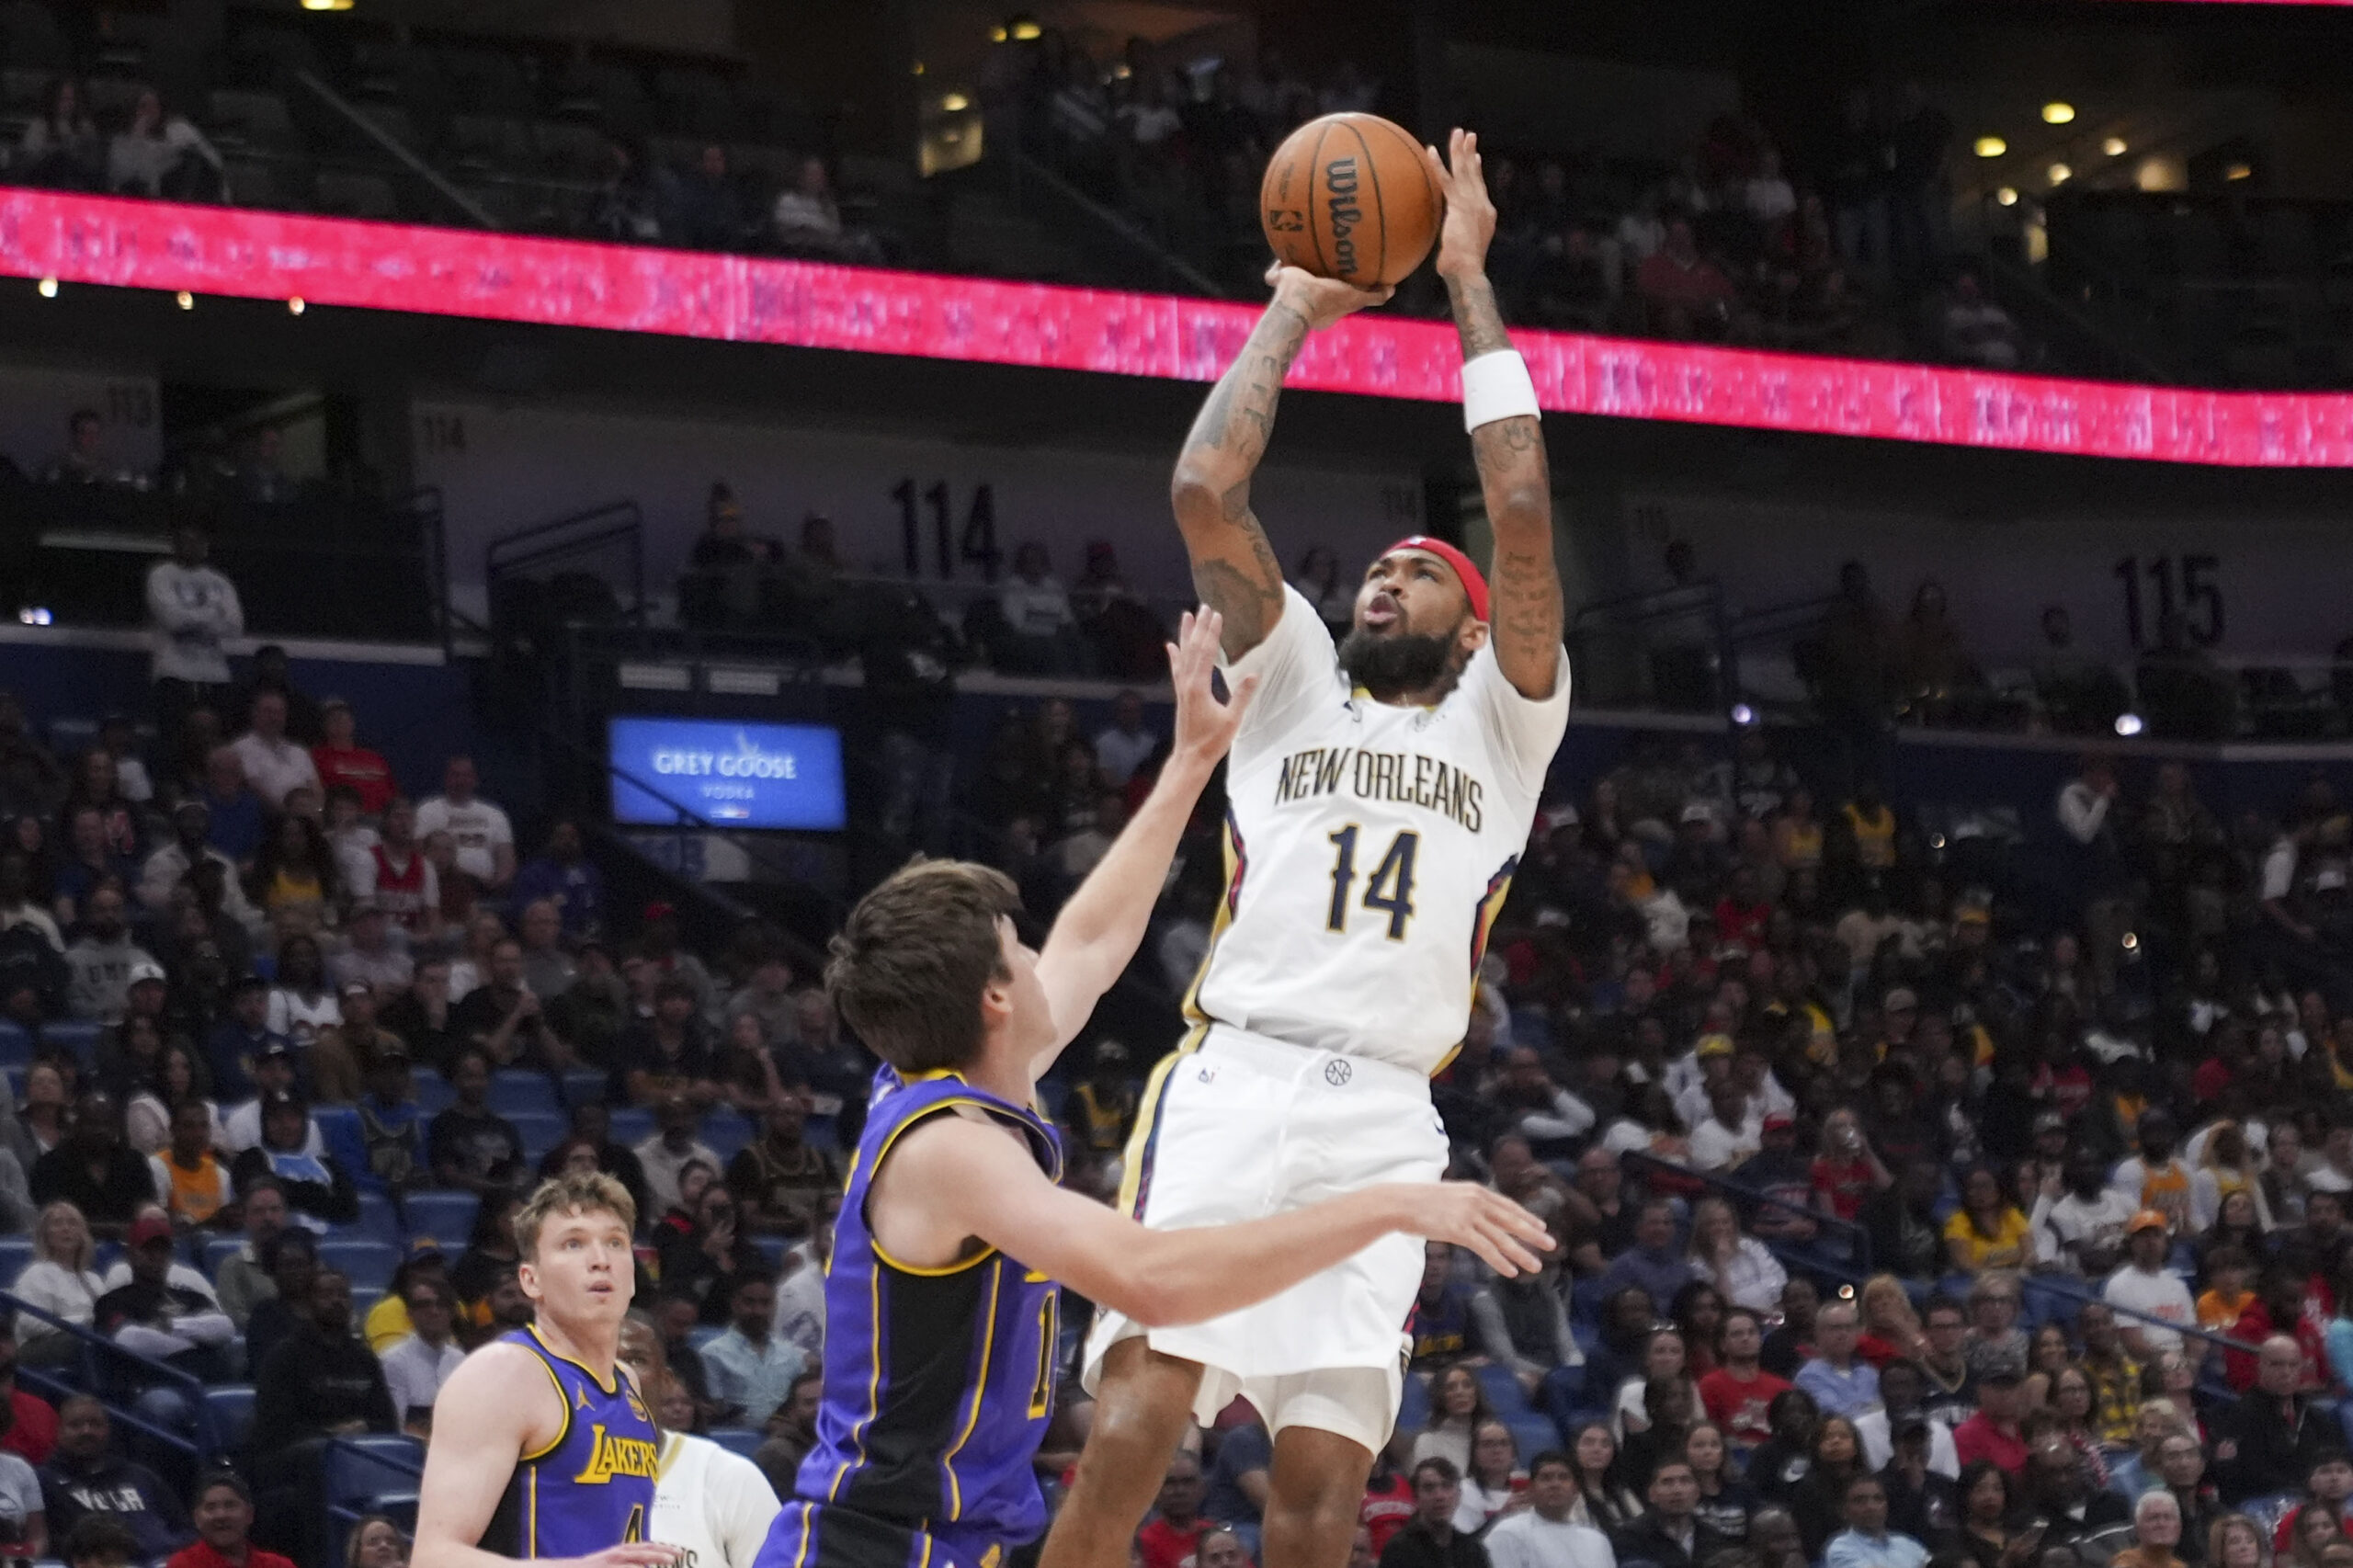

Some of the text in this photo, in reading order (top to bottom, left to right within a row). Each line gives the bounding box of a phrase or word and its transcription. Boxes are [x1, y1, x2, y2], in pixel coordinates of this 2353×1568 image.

[1326, 156, 1362, 276] Wilson
[891, 478, 1003, 584] 114
[2113, 554, 2224, 648] 115
[654, 751, 797, 779] GREY GOOSE
[1274, 746, 1483, 834] NEW ORLEANS
[1325, 822, 1422, 943] 14
[573, 1424, 661, 1487] LAKERS
